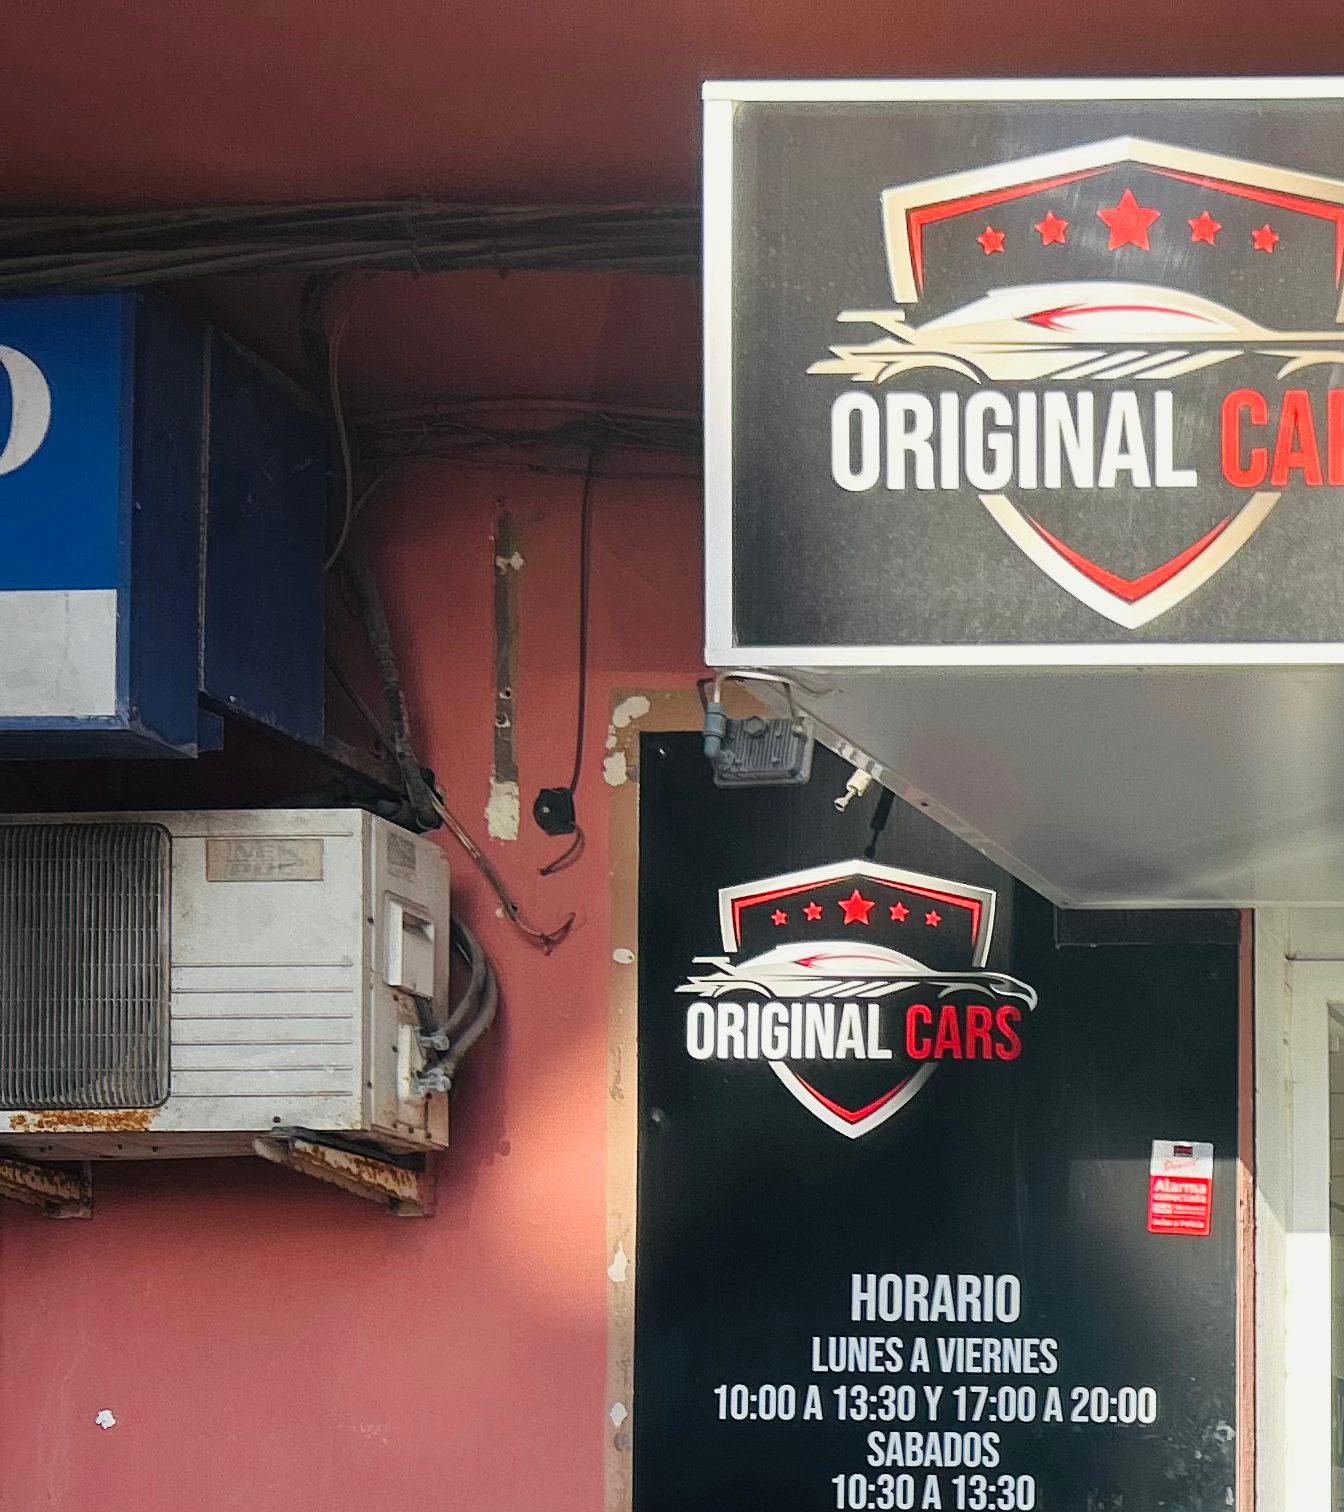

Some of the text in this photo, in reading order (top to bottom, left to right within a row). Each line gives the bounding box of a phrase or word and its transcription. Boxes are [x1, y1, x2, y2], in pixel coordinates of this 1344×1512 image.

[830, 390, 1198, 492] ORIGINAL
[686, 1002, 1023, 1061] ORIGINAL CARS
[1153, 1179, 1207, 1195] Alarma
[850, 1274, 1021, 1323] HORARIO
[812, 1336, 1059, 1375] LUNES A VIERNES
[713, 1384, 1158, 1424] 10:00 A 13:30 Y 17:00 A 20:00
[866, 1431, 1001, 1469] SABADOS
[831, 1474, 1037, 1512] 10:30 A 13:30
